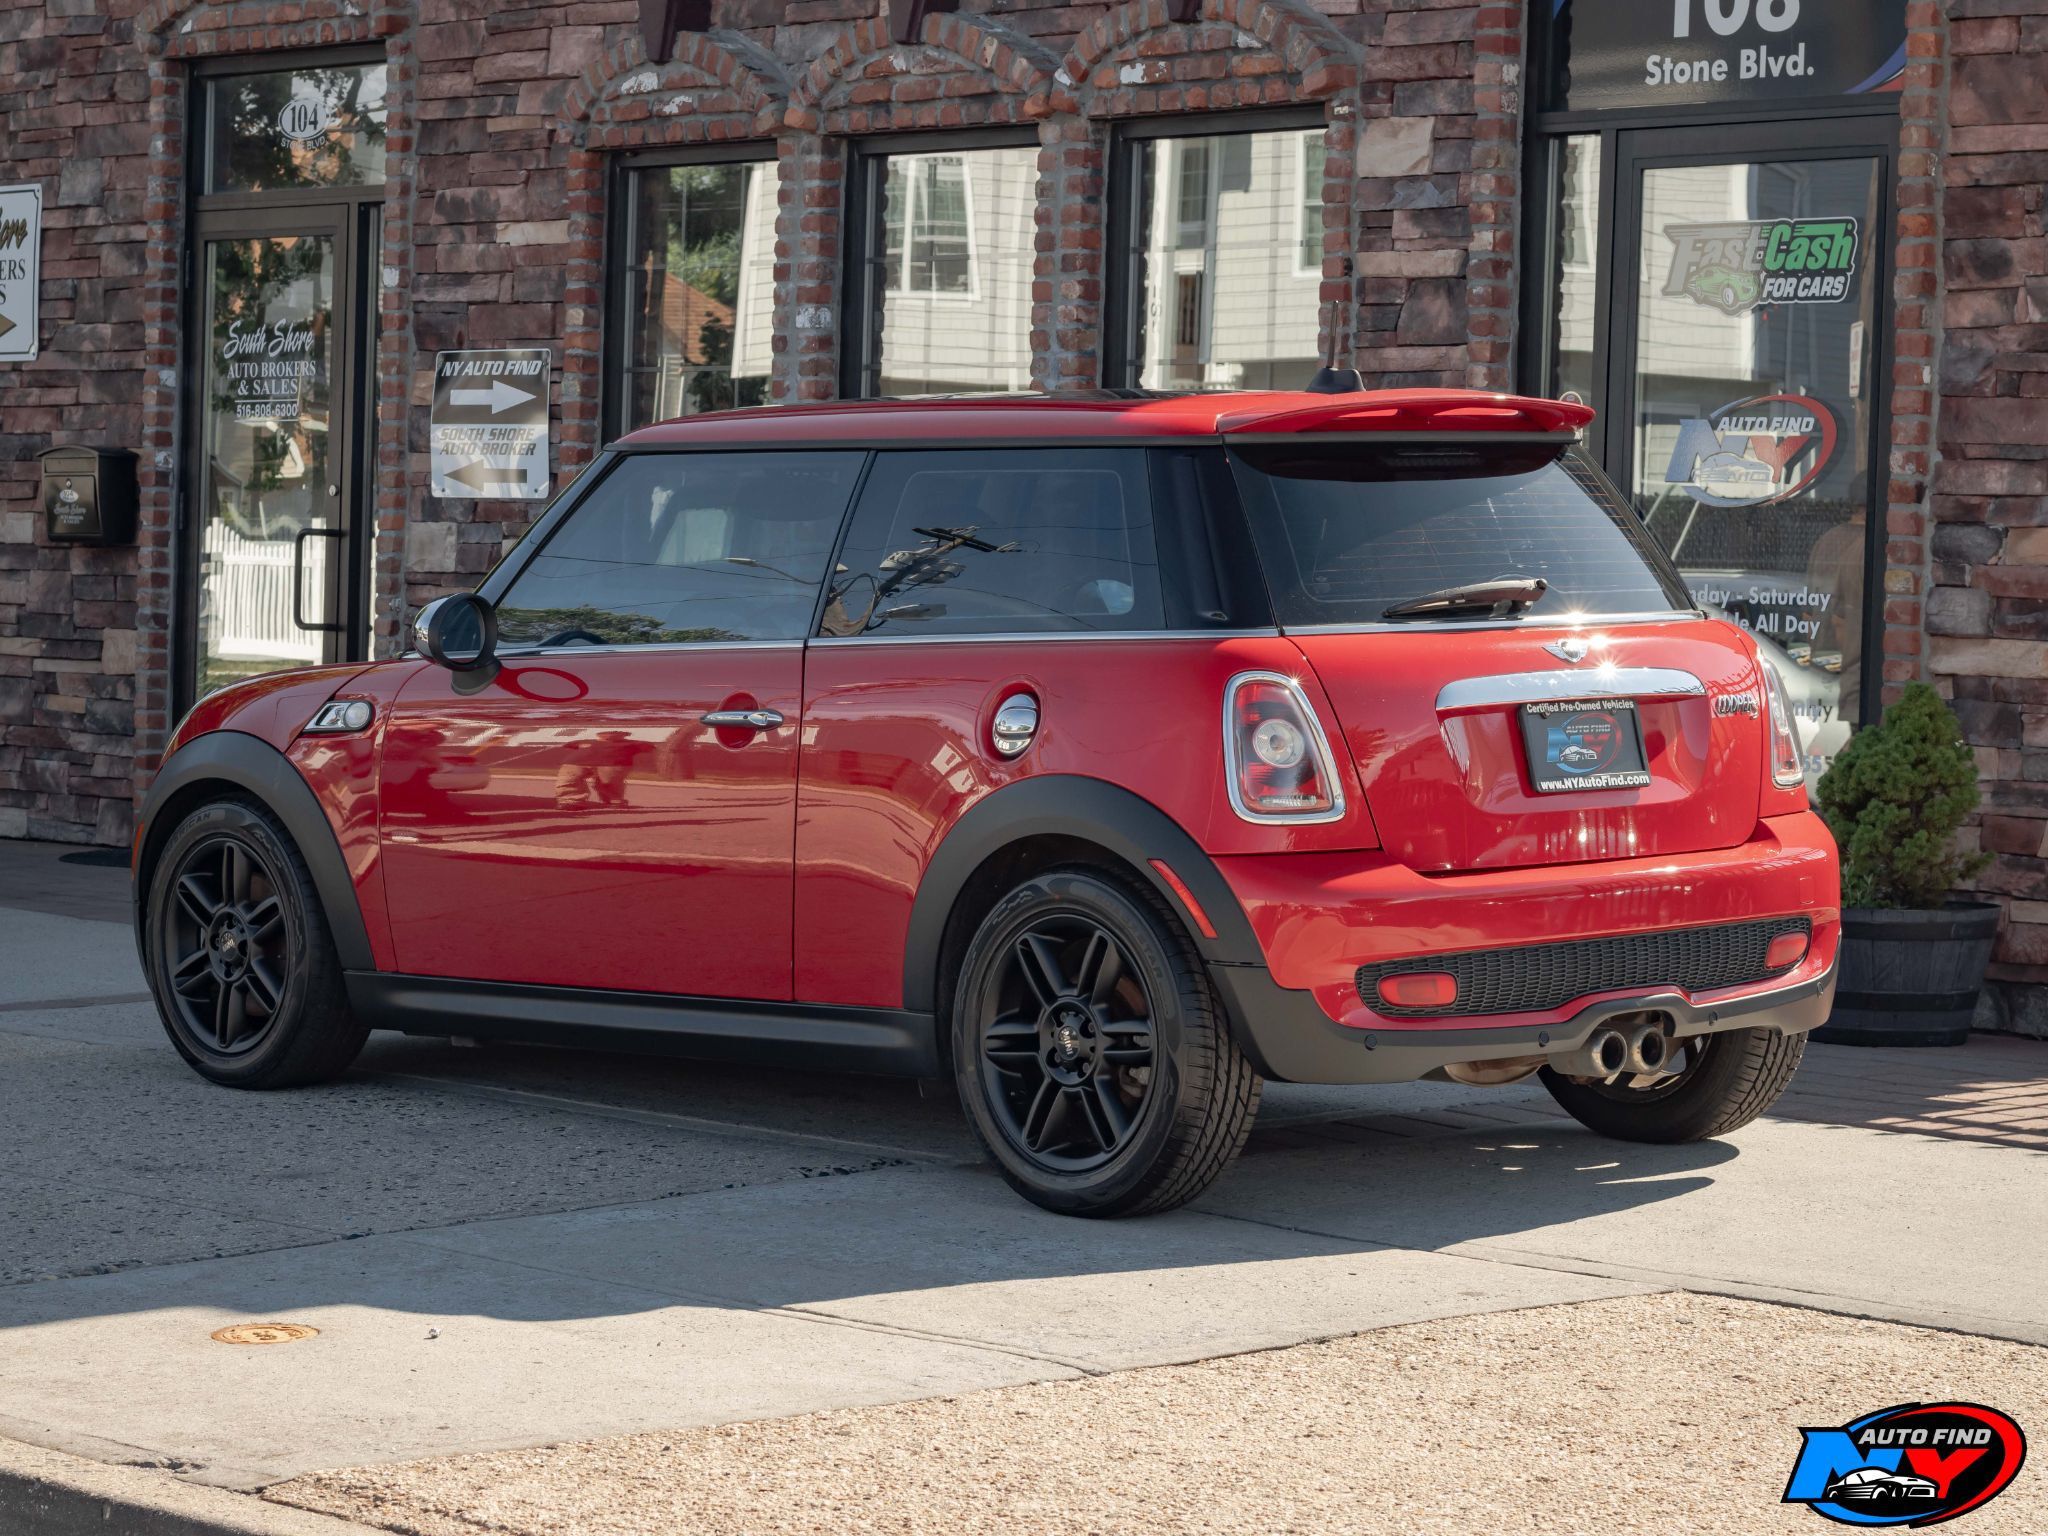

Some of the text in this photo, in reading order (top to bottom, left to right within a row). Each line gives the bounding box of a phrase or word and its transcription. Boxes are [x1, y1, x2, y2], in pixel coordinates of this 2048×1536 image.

[1644, 42, 1815, 86] Stone Blvd.
[290, 103, 319, 133] 104
[0, 207, 28, 250] ore
[1667, 223, 1853, 291] Fast Cash
[1762, 275, 1846, 298] FOR CARS
[223, 318, 314, 359] South Shore
[227, 360, 316, 379] AUTO BROKERS
[441, 360, 543, 377] NY AUTO FIND
[238, 378, 298, 396] & SALES
[236, 403, 298, 417] 516-808-6300
[1717, 416, 1815, 432] AUTO FIND
[440, 428, 536, 441] SOUTH SHORE
[440, 442, 537, 456] AUTO BROKER
[1689, 583, 1730, 609] nday
[1748, 586, 1831, 612] Saturday
[1754, 613, 1779, 632] All
[1785, 615, 1821, 640] Day
[1526, 699, 1634, 713] Certified Pre-Owned Vehicles
[1566, 724, 1611, 733] AUTO FIND
[1540, 774, 1650, 790] www.NYAutoFind.com
